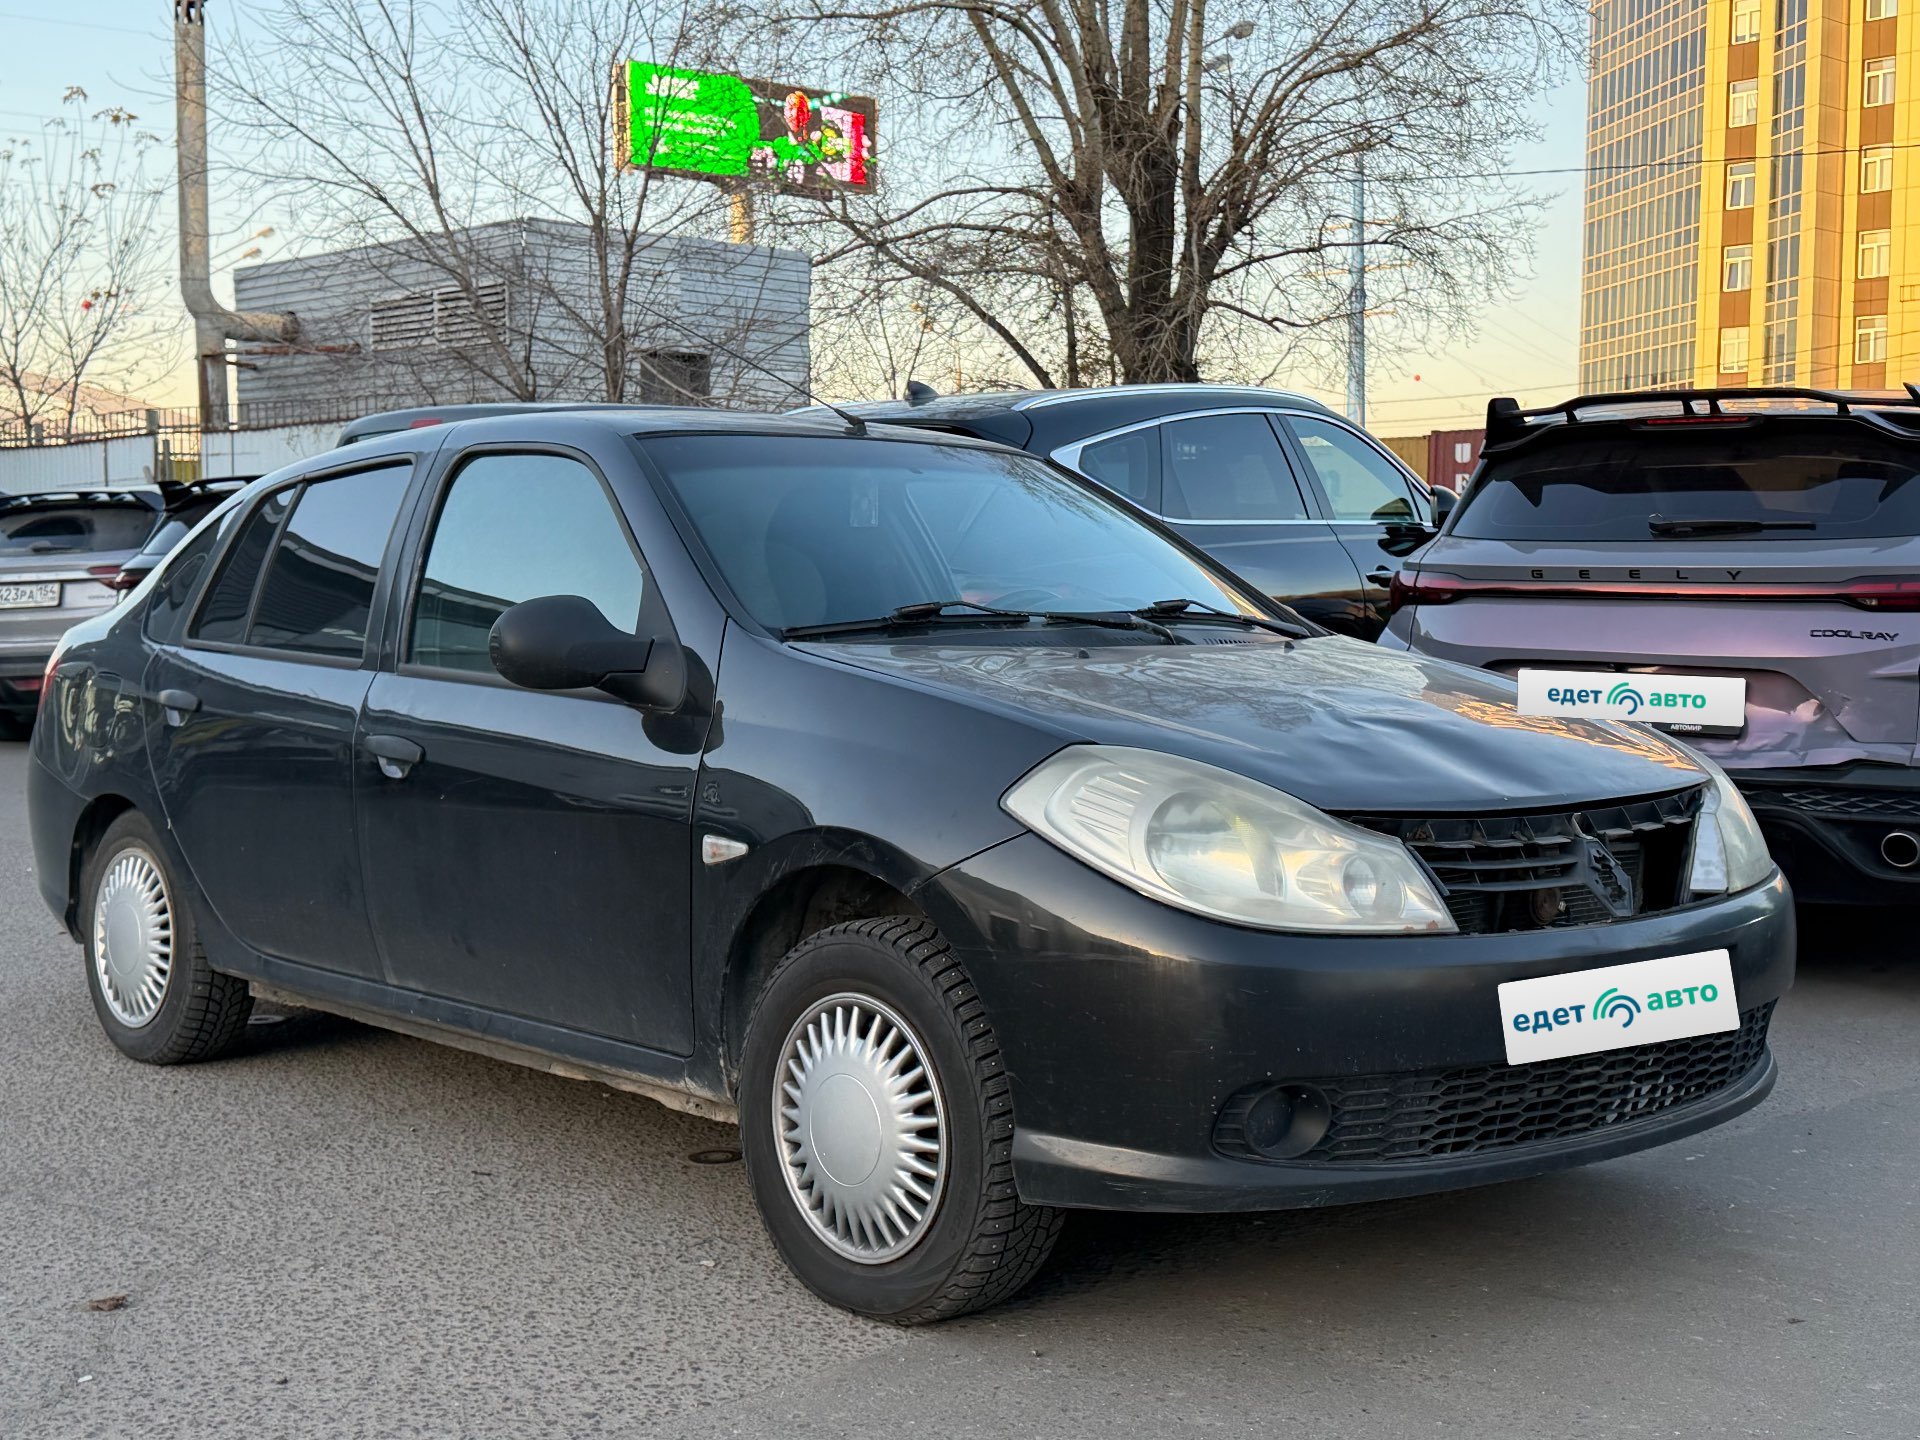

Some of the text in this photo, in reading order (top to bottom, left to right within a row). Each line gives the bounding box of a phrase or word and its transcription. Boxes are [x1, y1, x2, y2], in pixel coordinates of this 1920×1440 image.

[1531, 569, 1742, 581] GEELY
[1810, 629, 1899, 641] COOLRAY
[1670, 724, 1703, 732] АВТОМИР
